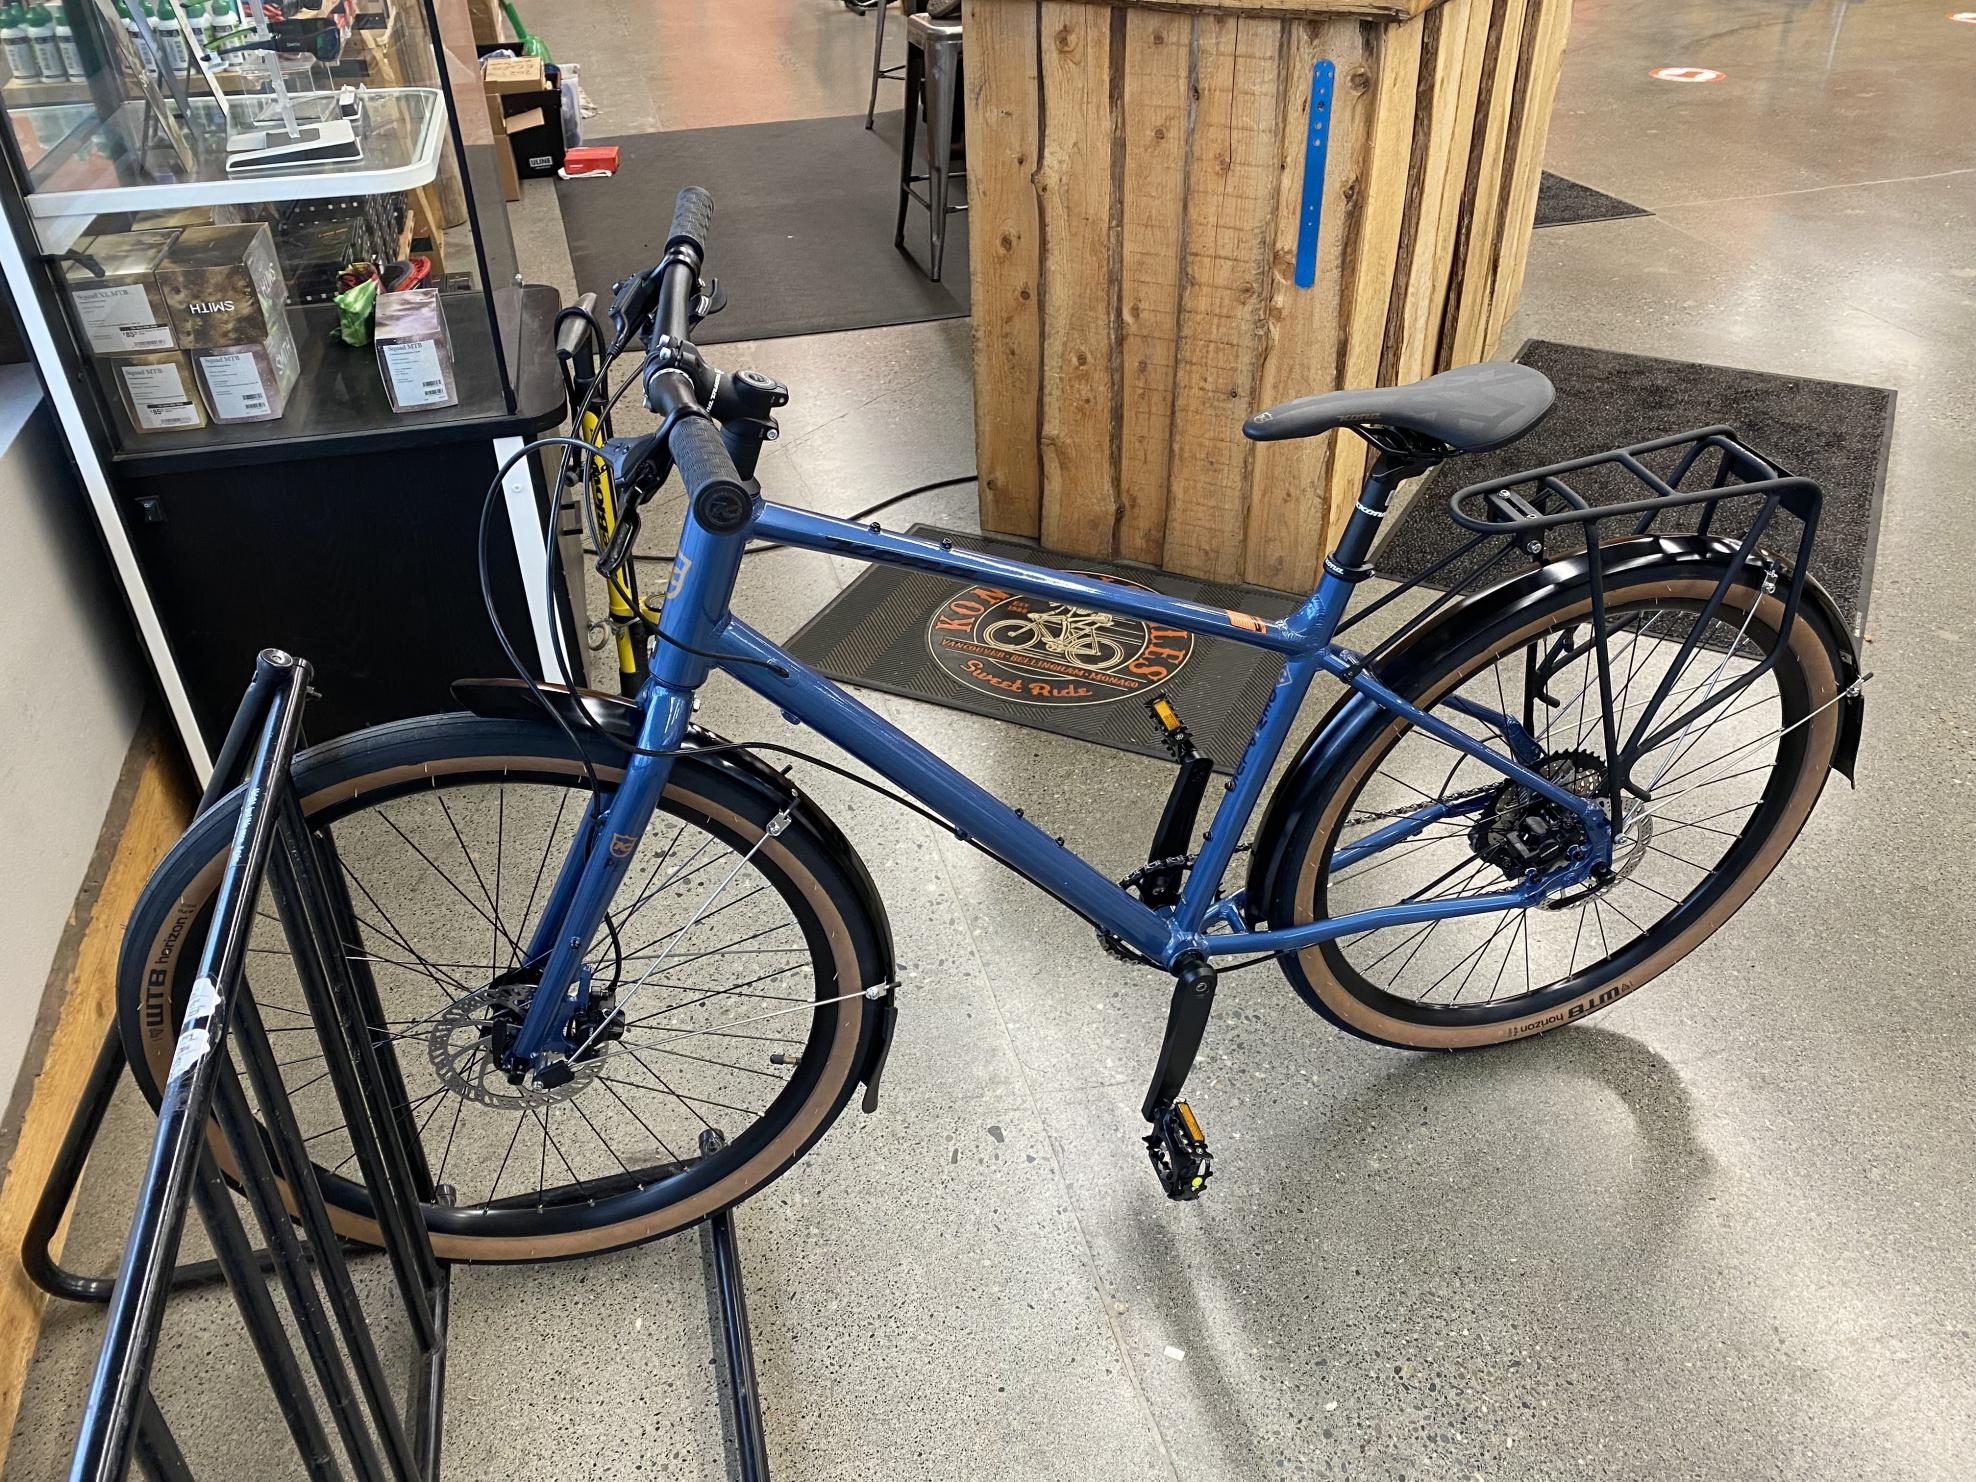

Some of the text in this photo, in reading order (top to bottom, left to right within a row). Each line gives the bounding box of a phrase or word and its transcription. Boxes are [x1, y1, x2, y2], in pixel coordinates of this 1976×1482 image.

[190, 300, 235, 315] SMITH
[387, 342, 423, 352] Squad MTB
[935, 588, 1011, 633] KON
[941, 639, 1140, 689] VANCOUVER BELLINGHAM MONACO
[960, 659, 1093, 698] Sweet Ride
[154, 916, 189, 965] horizon
[146, 968, 168, 1028] WTB
[1567, 986, 1620, 1019] WTB
[1520, 1012, 1564, 1033] horizon
